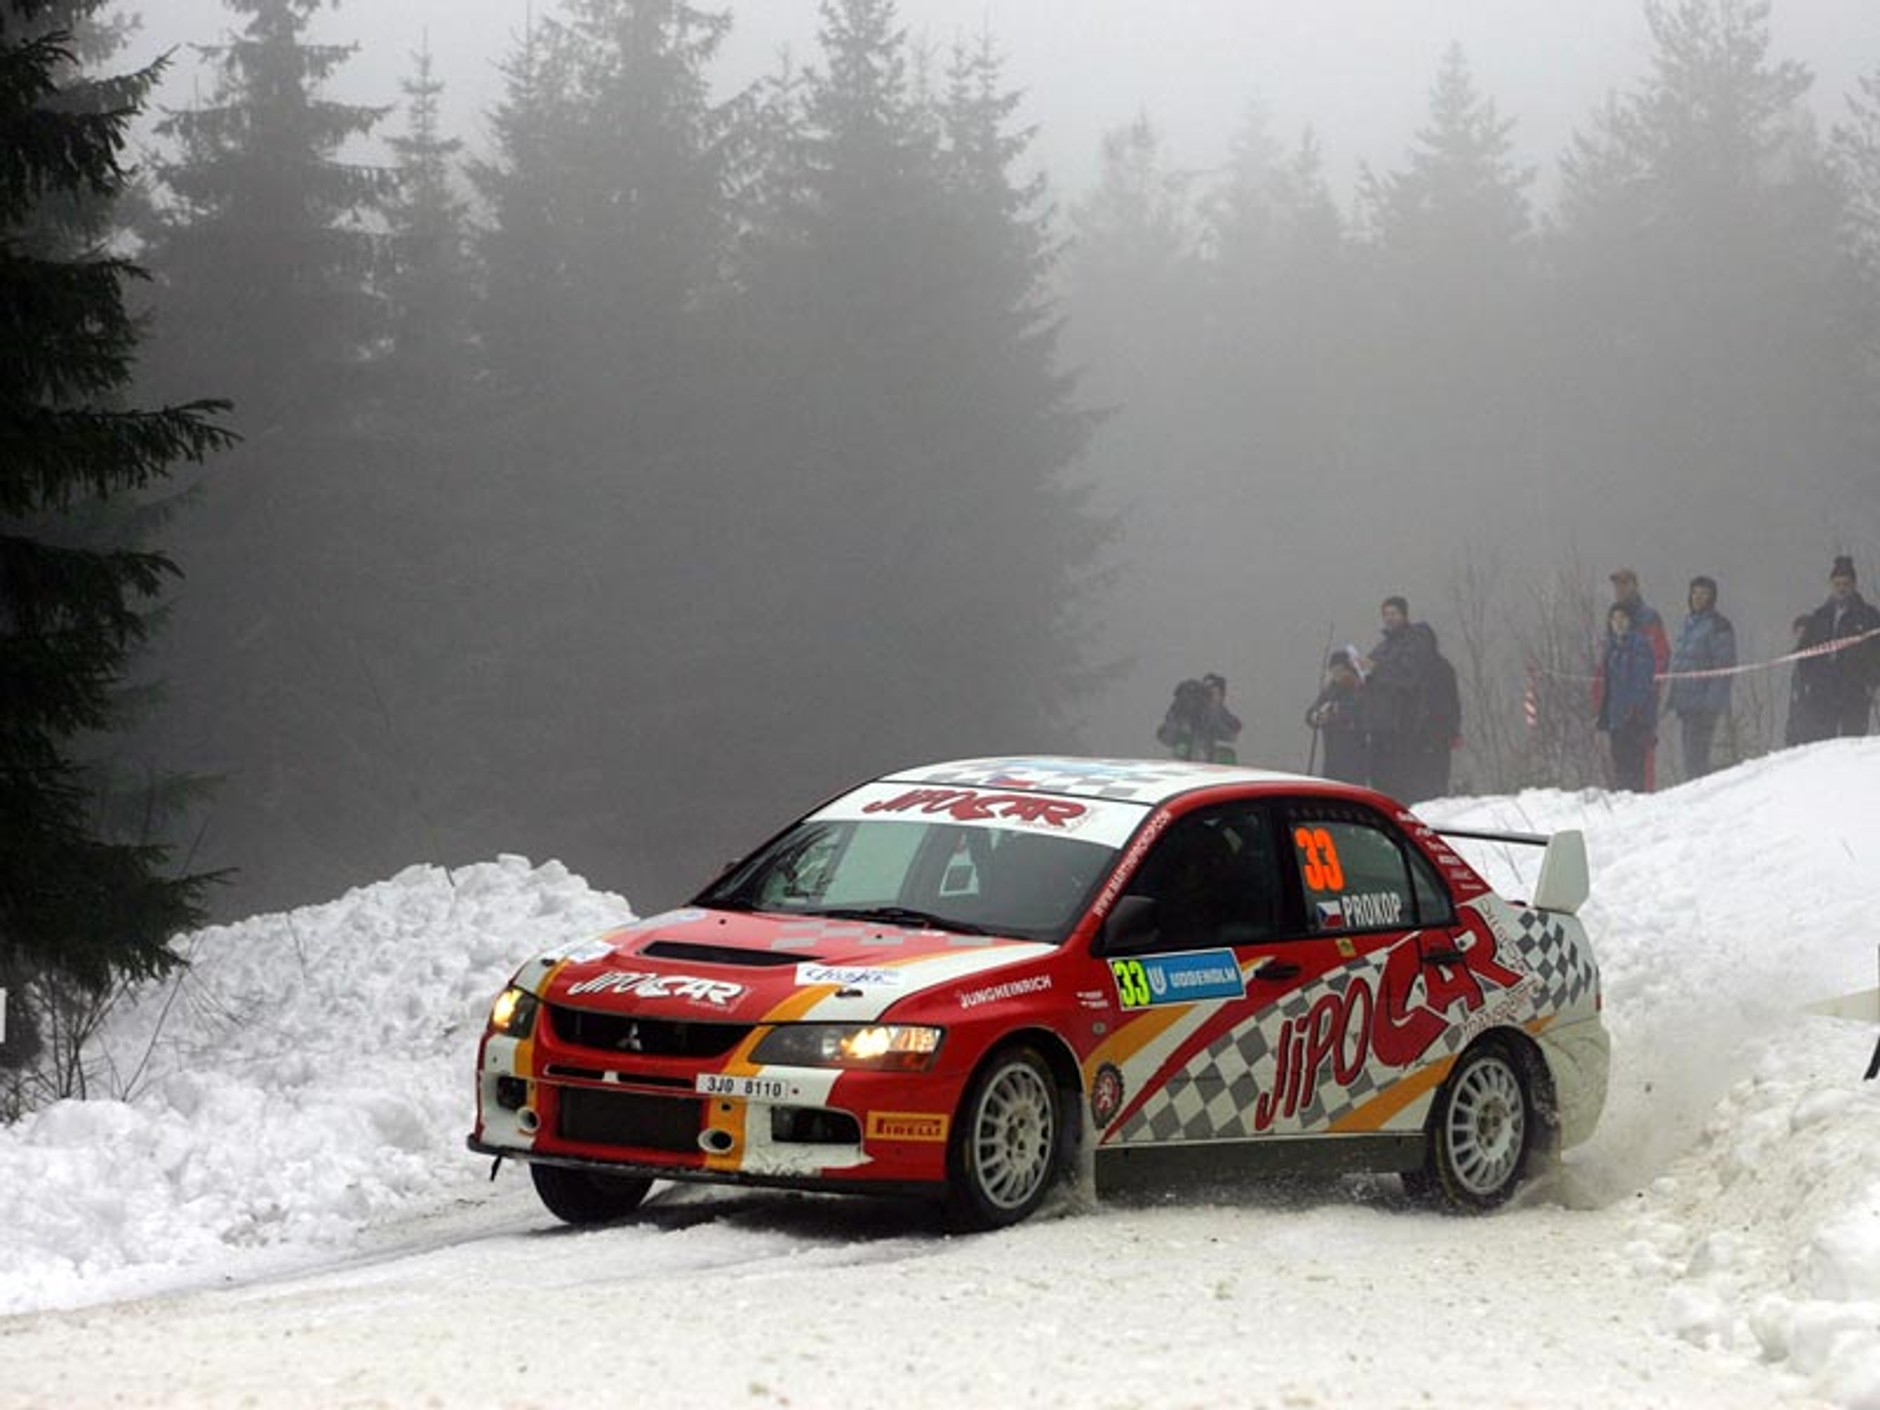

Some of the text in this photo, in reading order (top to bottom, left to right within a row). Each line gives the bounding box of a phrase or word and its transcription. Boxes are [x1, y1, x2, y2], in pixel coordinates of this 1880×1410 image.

[1294, 827, 1344, 891] 33
[1342, 892, 1402, 927] PROKOP
[960, 975, 1053, 1009] JUNGHEINRICH
[1113, 959, 1151, 1007] 33
[744, 1080, 782, 1097] 8110
[876, 1117, 942, 1137] PIRELLI
